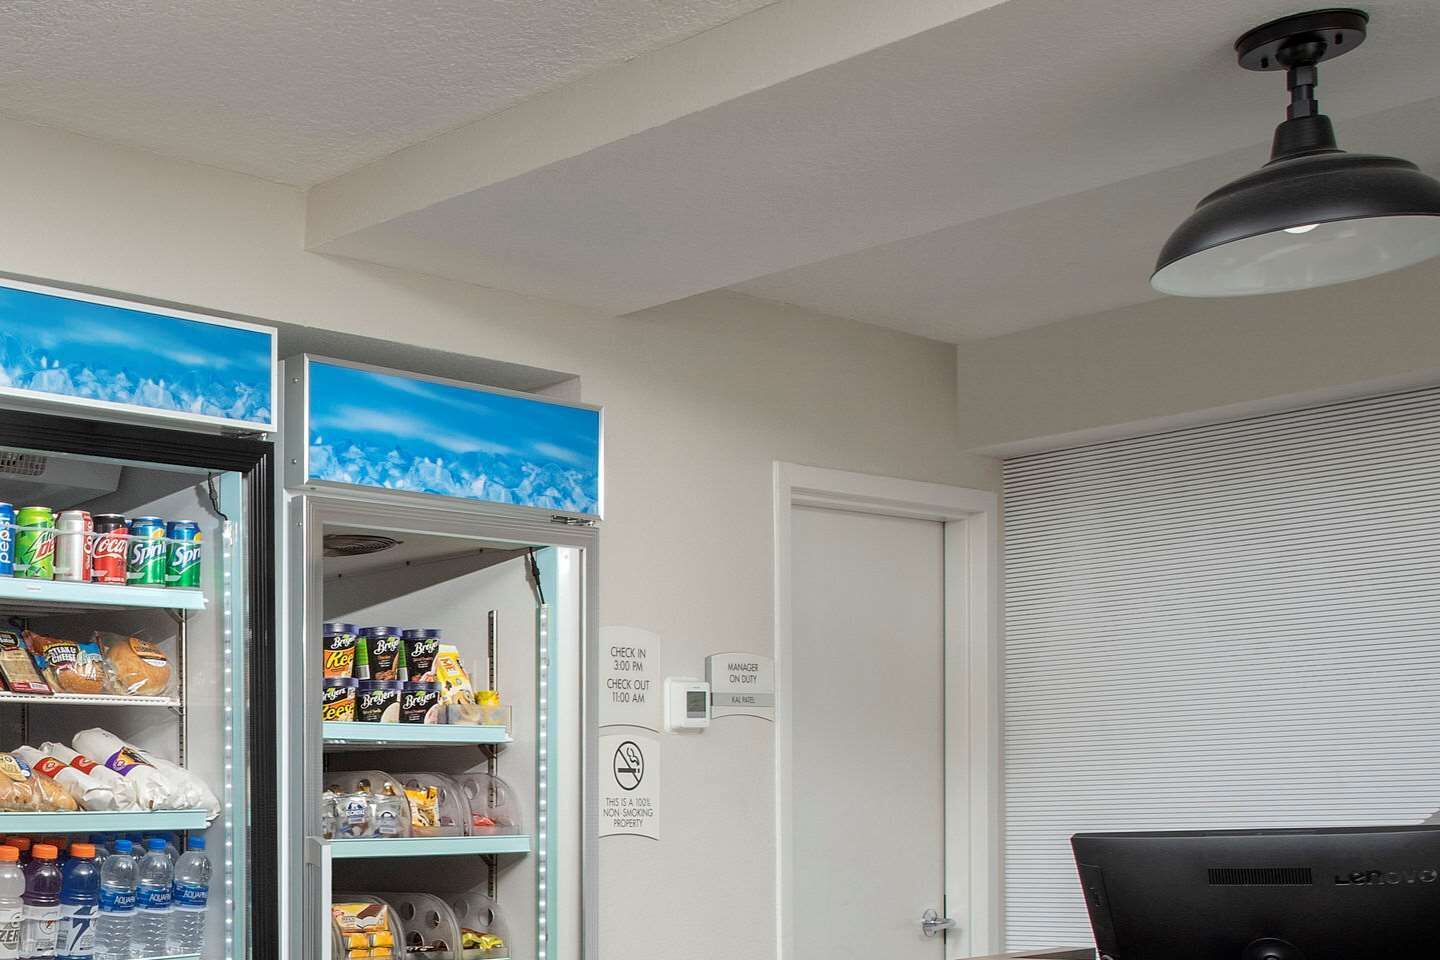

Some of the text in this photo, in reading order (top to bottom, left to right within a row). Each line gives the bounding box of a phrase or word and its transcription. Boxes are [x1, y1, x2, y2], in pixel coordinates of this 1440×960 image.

[0, 517, 11, 564] pepsi
[52, 653, 75, 663] CHEESE
[610, 646, 646, 658] CHECK IN
[614, 660, 643, 672] 3:00 PM
[728, 663, 759, 672] MANAGER
[607, 678, 650, 690] CHECK OUT
[730, 674, 758, 684] ON DUTY
[360, 690, 394, 710] Breyers
[403, 690, 437, 710] Breyers
[612, 692, 645, 703] 11:00 AM
[614, 819, 643, 828] PROPERTY
